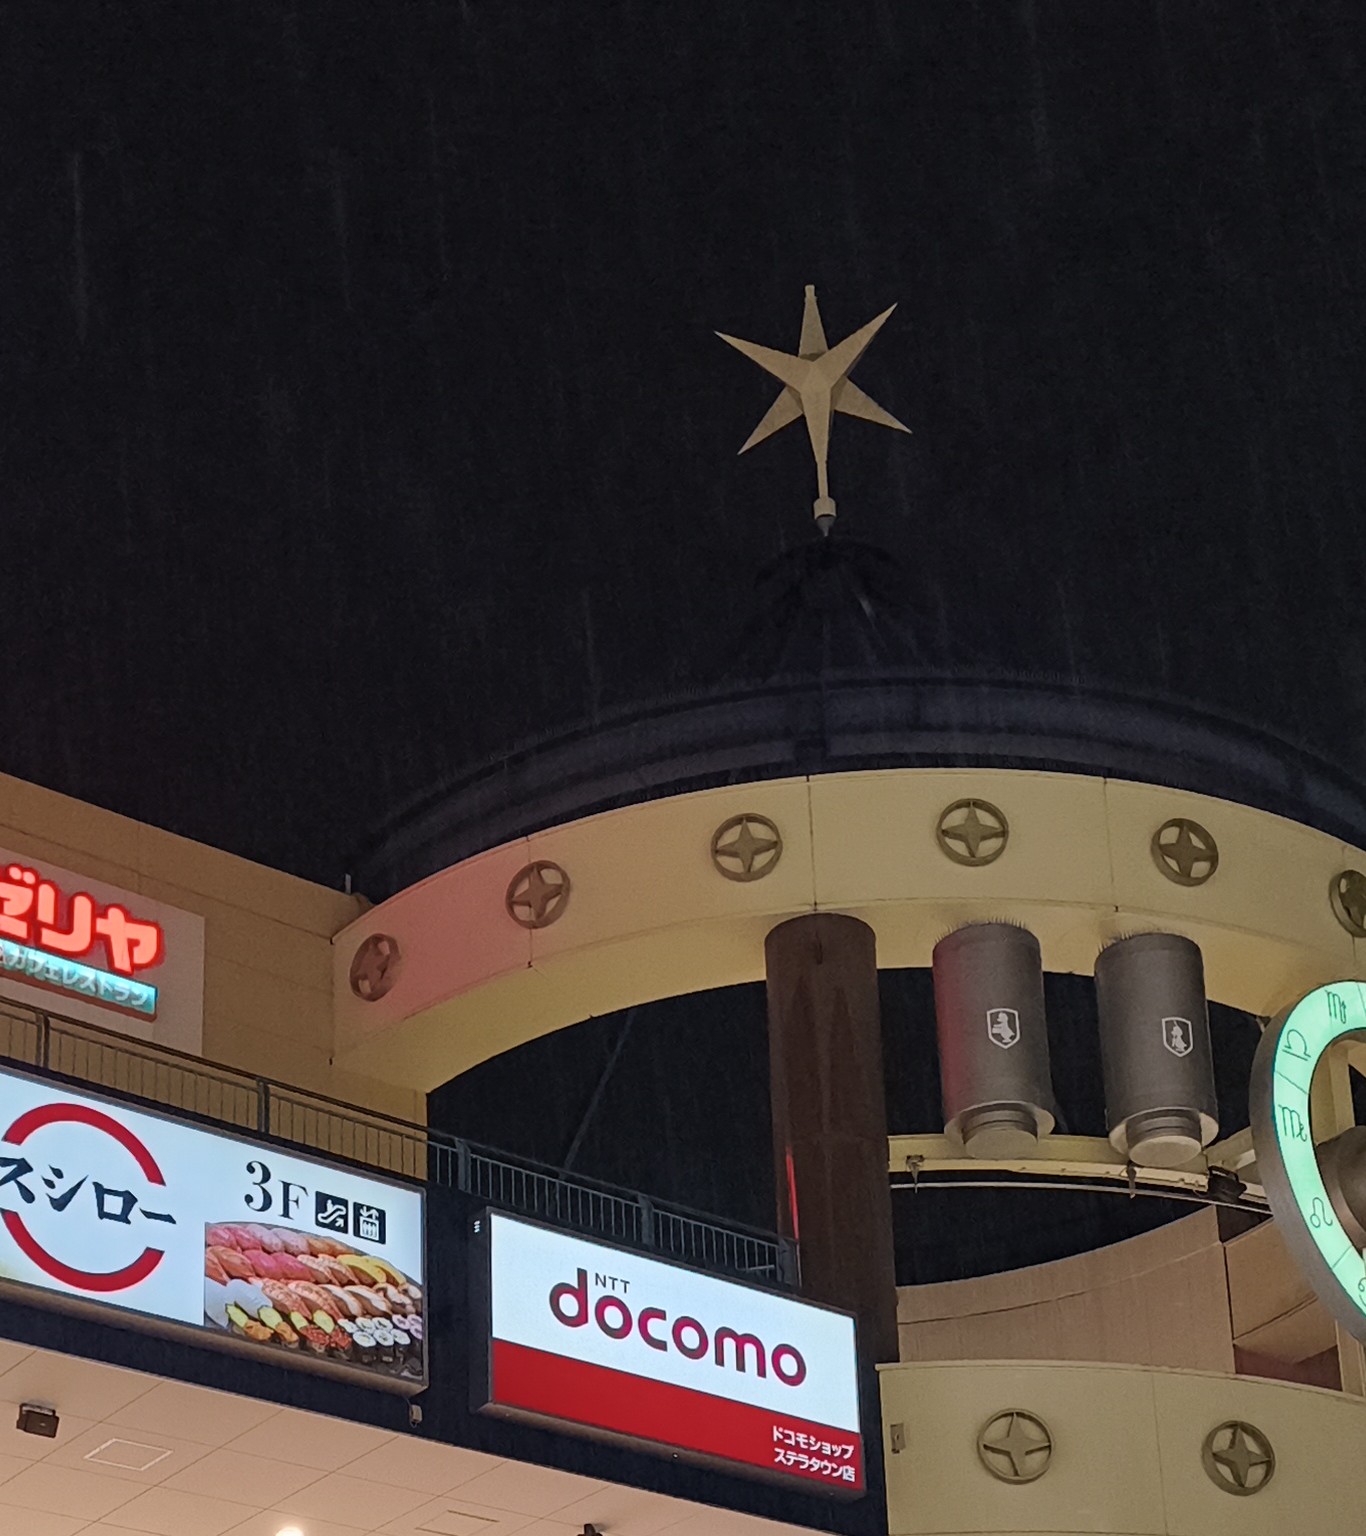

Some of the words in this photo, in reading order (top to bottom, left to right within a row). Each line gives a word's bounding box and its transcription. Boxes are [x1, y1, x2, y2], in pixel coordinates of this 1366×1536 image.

[244, 1160, 309, 1220] 3F
[594, 1272, 630, 1294] NTT
[549, 1268, 807, 1387] docomo
[773, 1425, 854, 1459] ドコモショップ
[774, 1447, 855, 1482] ステラタウン店
